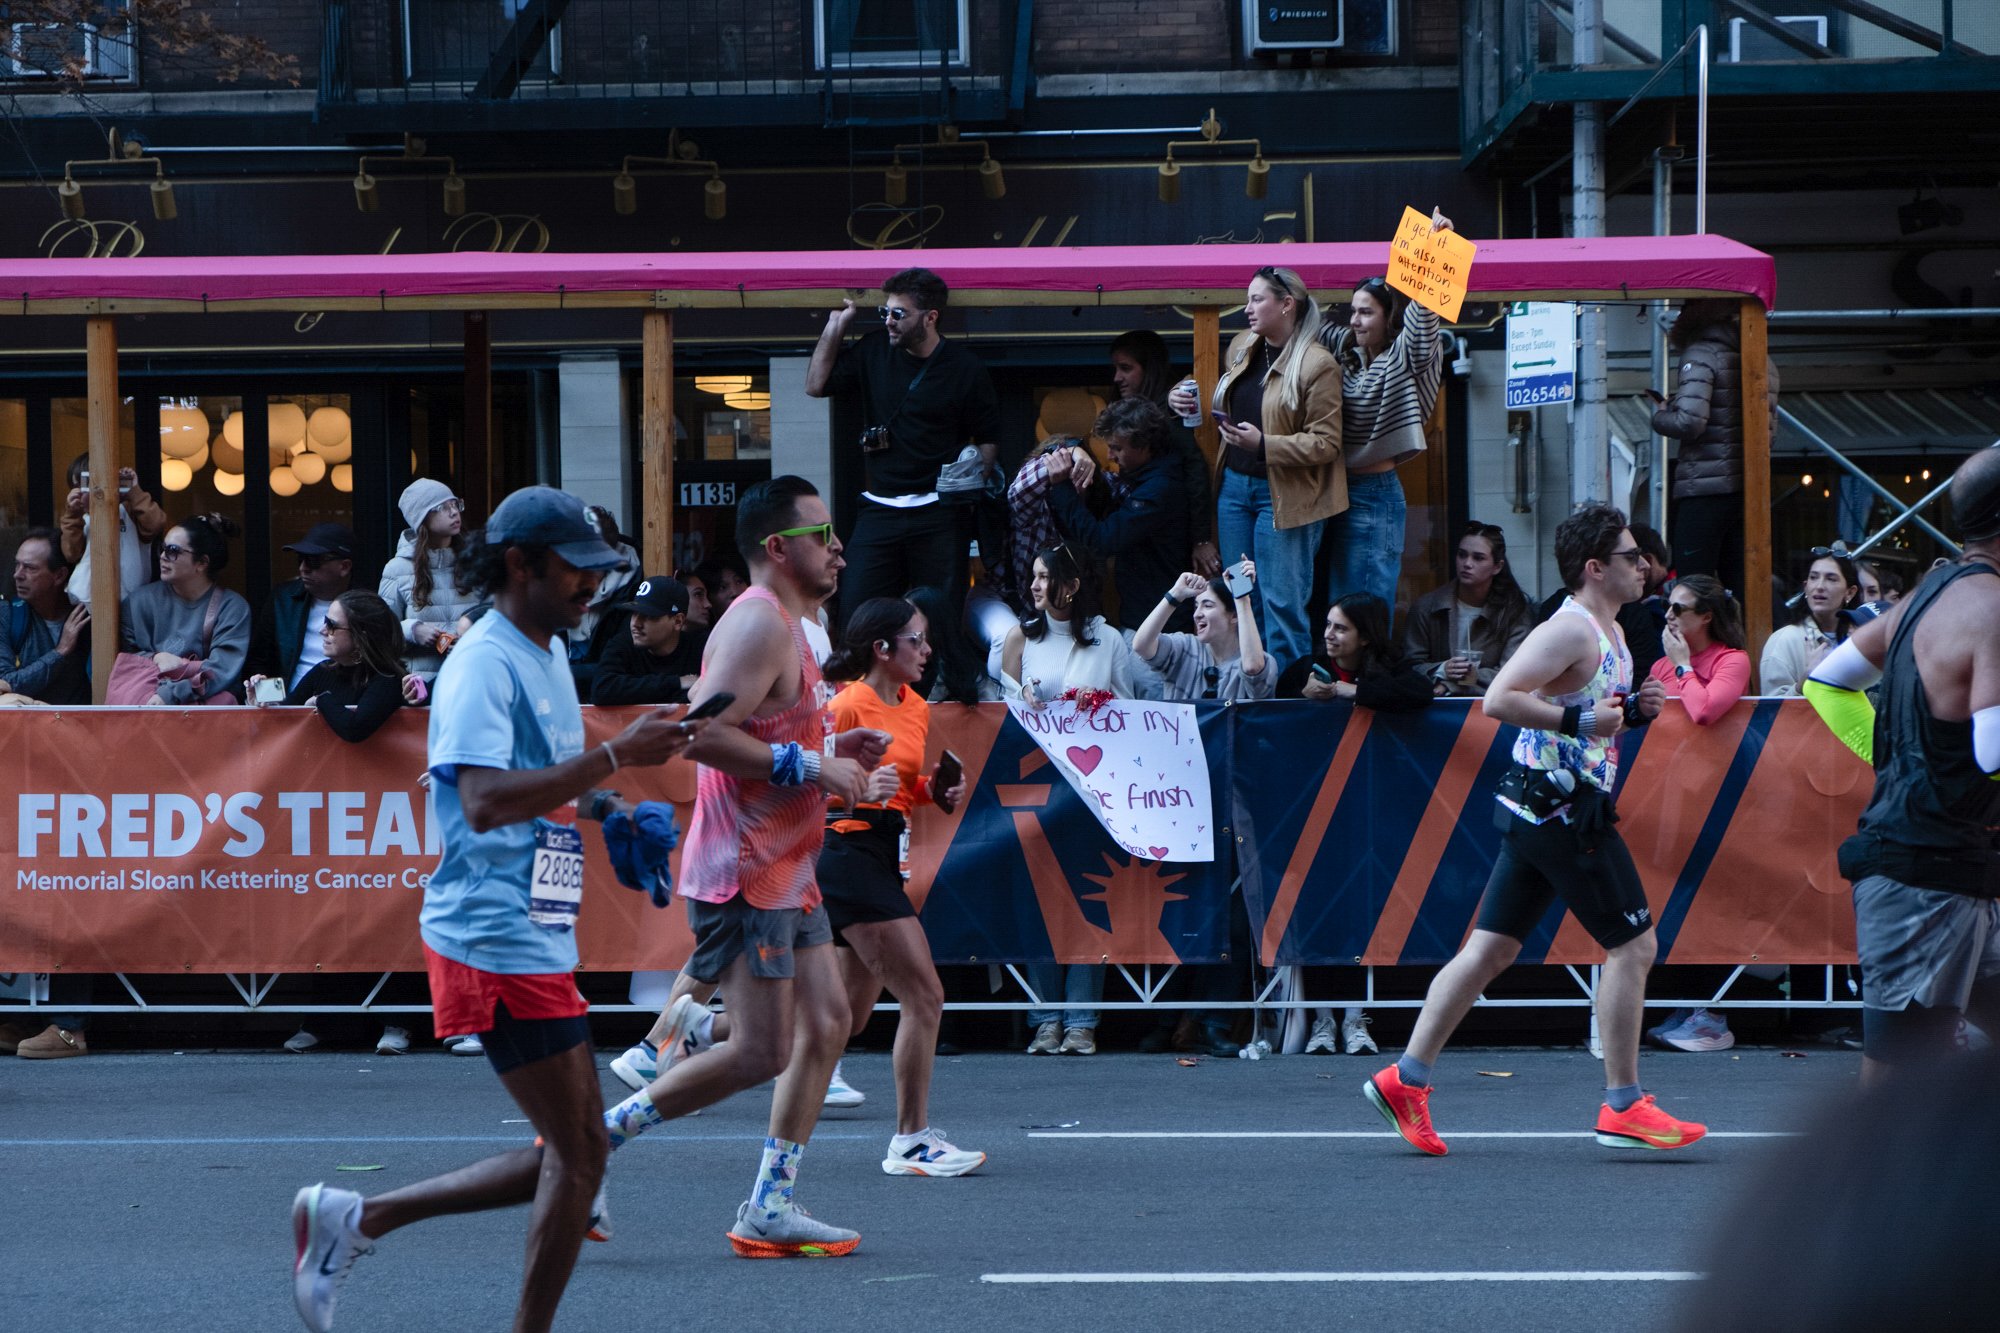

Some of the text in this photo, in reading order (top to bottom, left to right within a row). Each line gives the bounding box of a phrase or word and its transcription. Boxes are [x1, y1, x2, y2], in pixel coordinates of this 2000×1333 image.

[1280, 10, 1328, 18] FRIEDRICH
[1398, 255, 1451, 288] attention
[1414, 247, 1436, 264] also
[1442, 263, 1456, 275] an
[1400, 273, 1435, 296] whore
[1511, 329, 1525, 339] 8am
[1530, 328, 1544, 338] 7pm
[1511, 340, 1557, 353] Except Sunday
[1508, 385, 1557, 405] 102654
[683, 483, 733, 505] 1135
[636, 581, 651, 596] D
[18, 792, 266, 858] FRED'S
[17, 869, 125, 890] Memorial
[130, 869, 194, 890] Sloan
[200, 868, 309, 894] Kettering
[314, 868, 396, 889] Cancer
